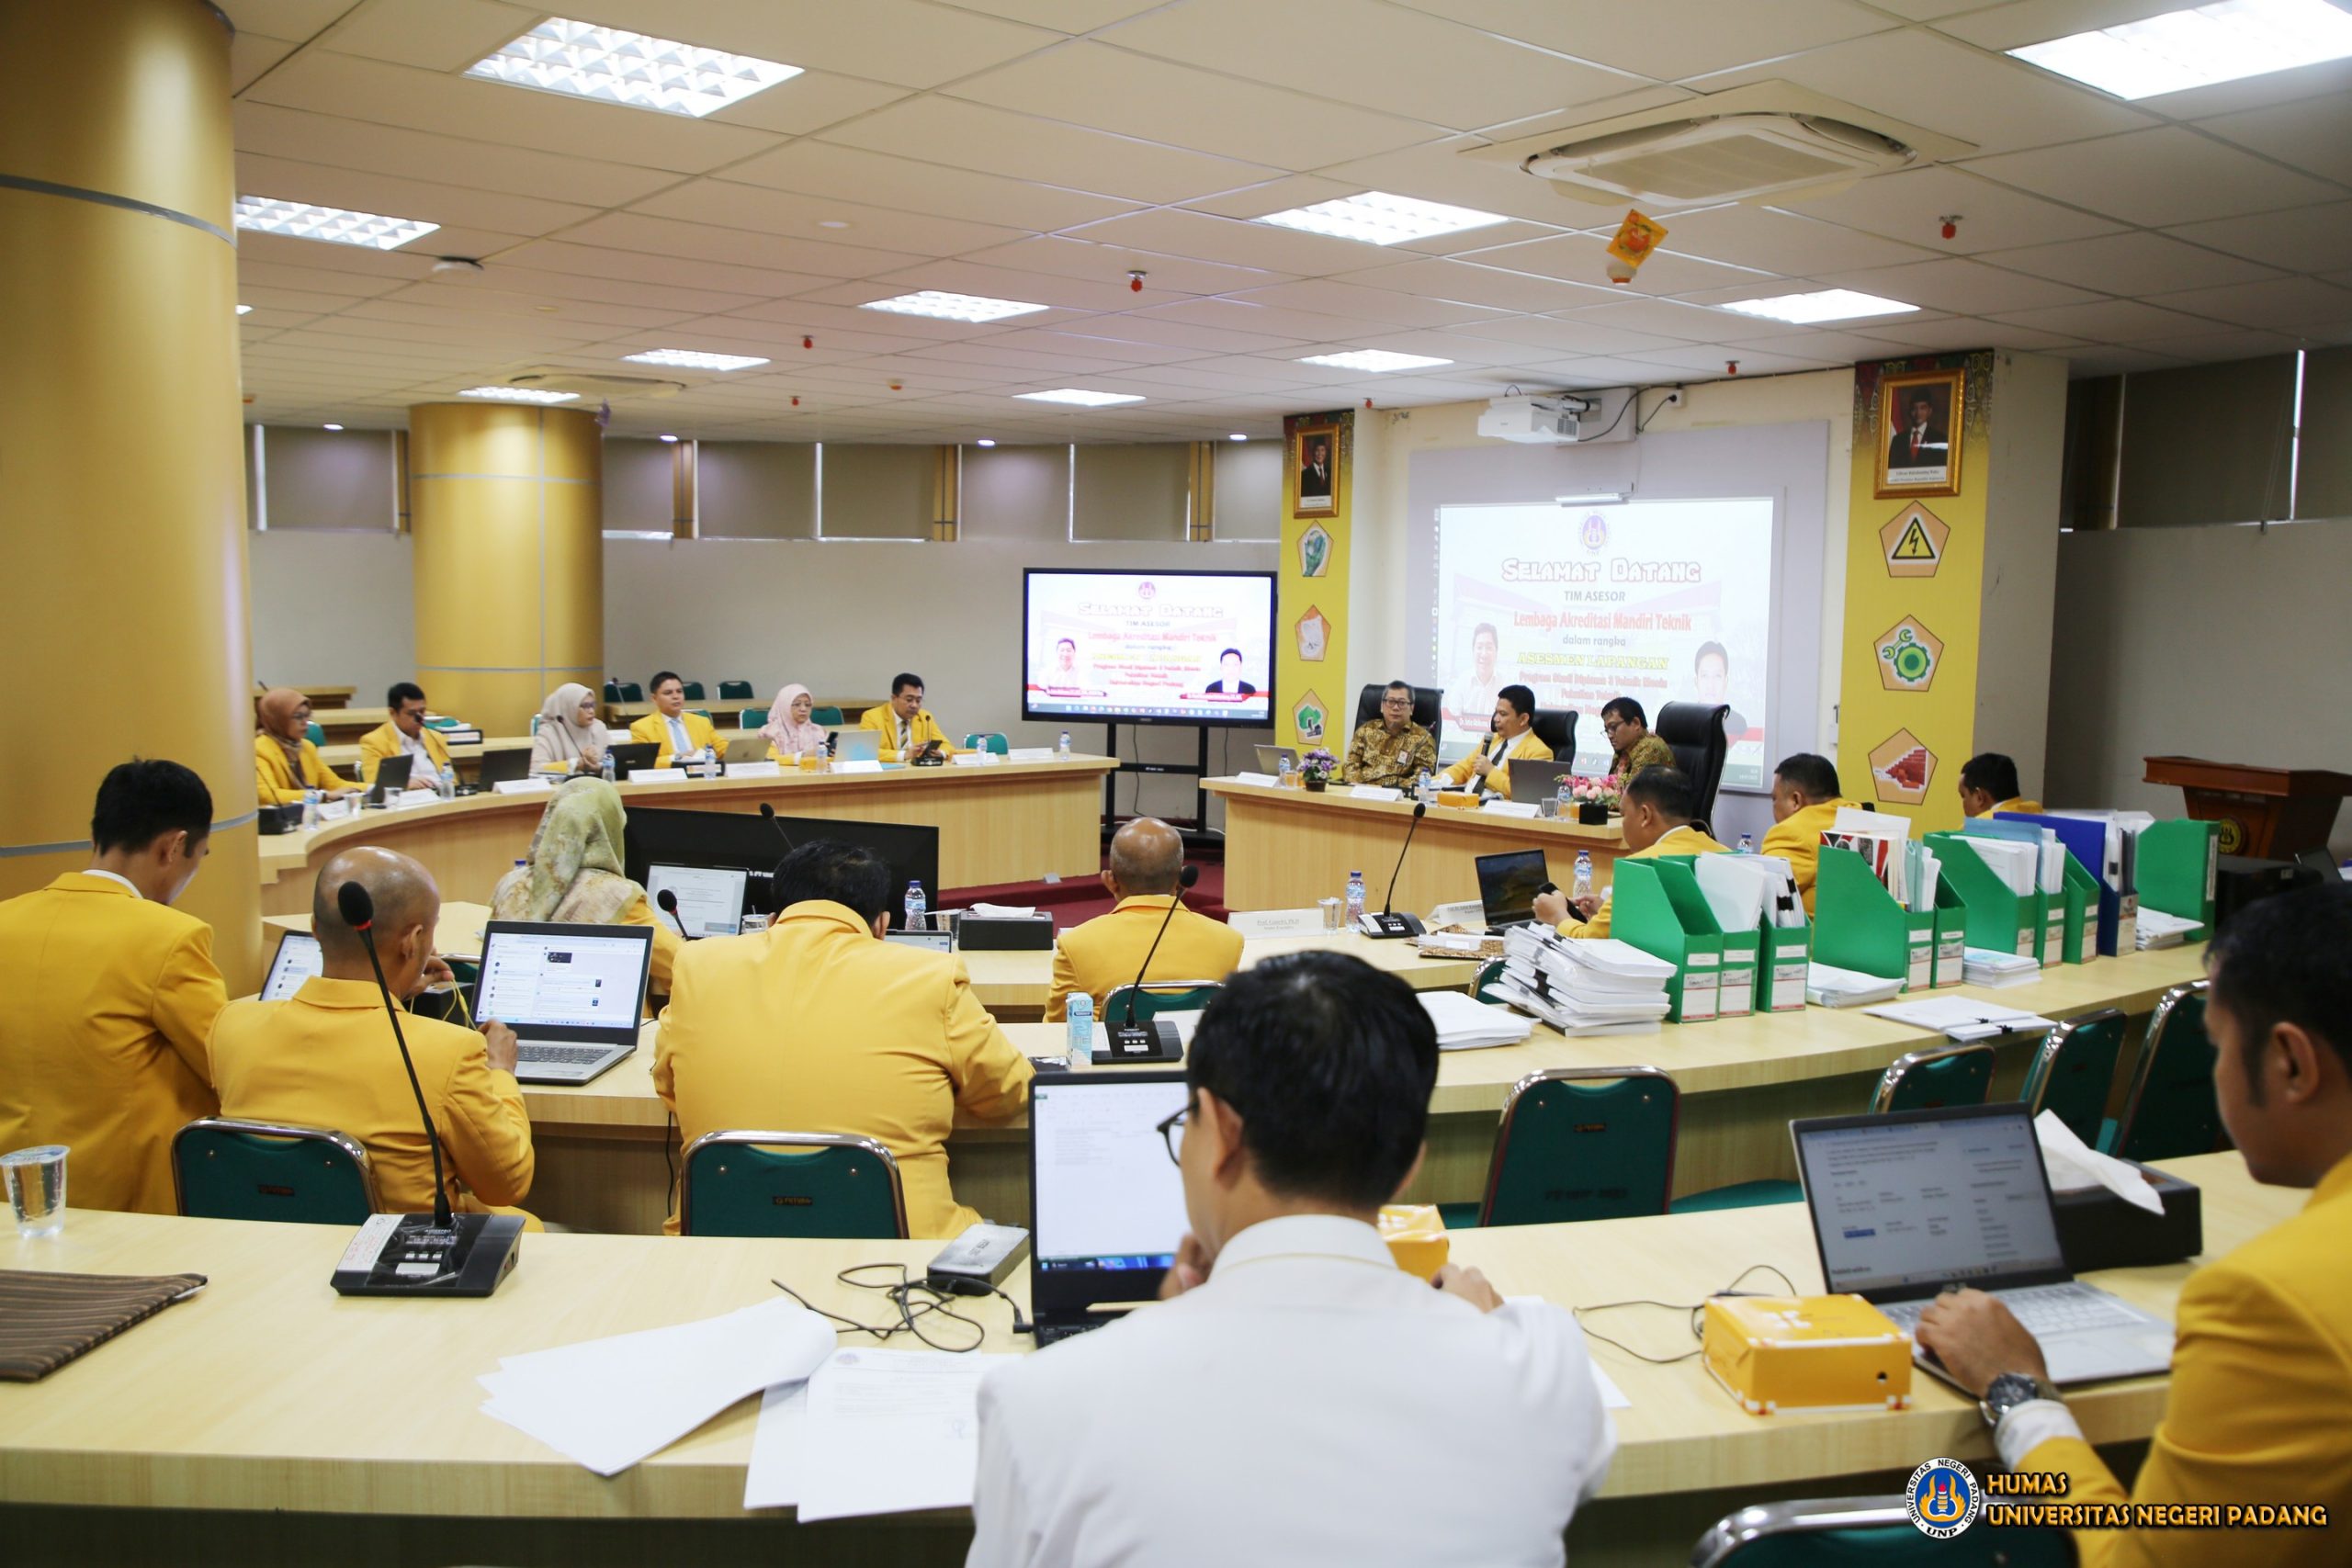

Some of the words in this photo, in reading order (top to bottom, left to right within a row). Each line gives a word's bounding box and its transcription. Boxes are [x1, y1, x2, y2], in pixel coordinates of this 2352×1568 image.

[1502, 558, 1600, 581] SELAMAT
[1611, 558, 1702, 582] DATANG
[1564, 591, 1582, 602] TIM
[1585, 591, 1625, 602] ASESOR
[1514, 612, 1557, 631] Lembaga
[1560, 612, 1611, 629] Akreditasi
[1613, 613, 1653, 630] Mandiri
[1656, 614, 1691, 631] Teknik
[1563, 634, 1590, 645] dalam
[1593, 636, 1626, 648] rangka
[1517, 652, 1585, 667] ASESMEN
[1588, 654, 1669, 671] LAPANGAN
